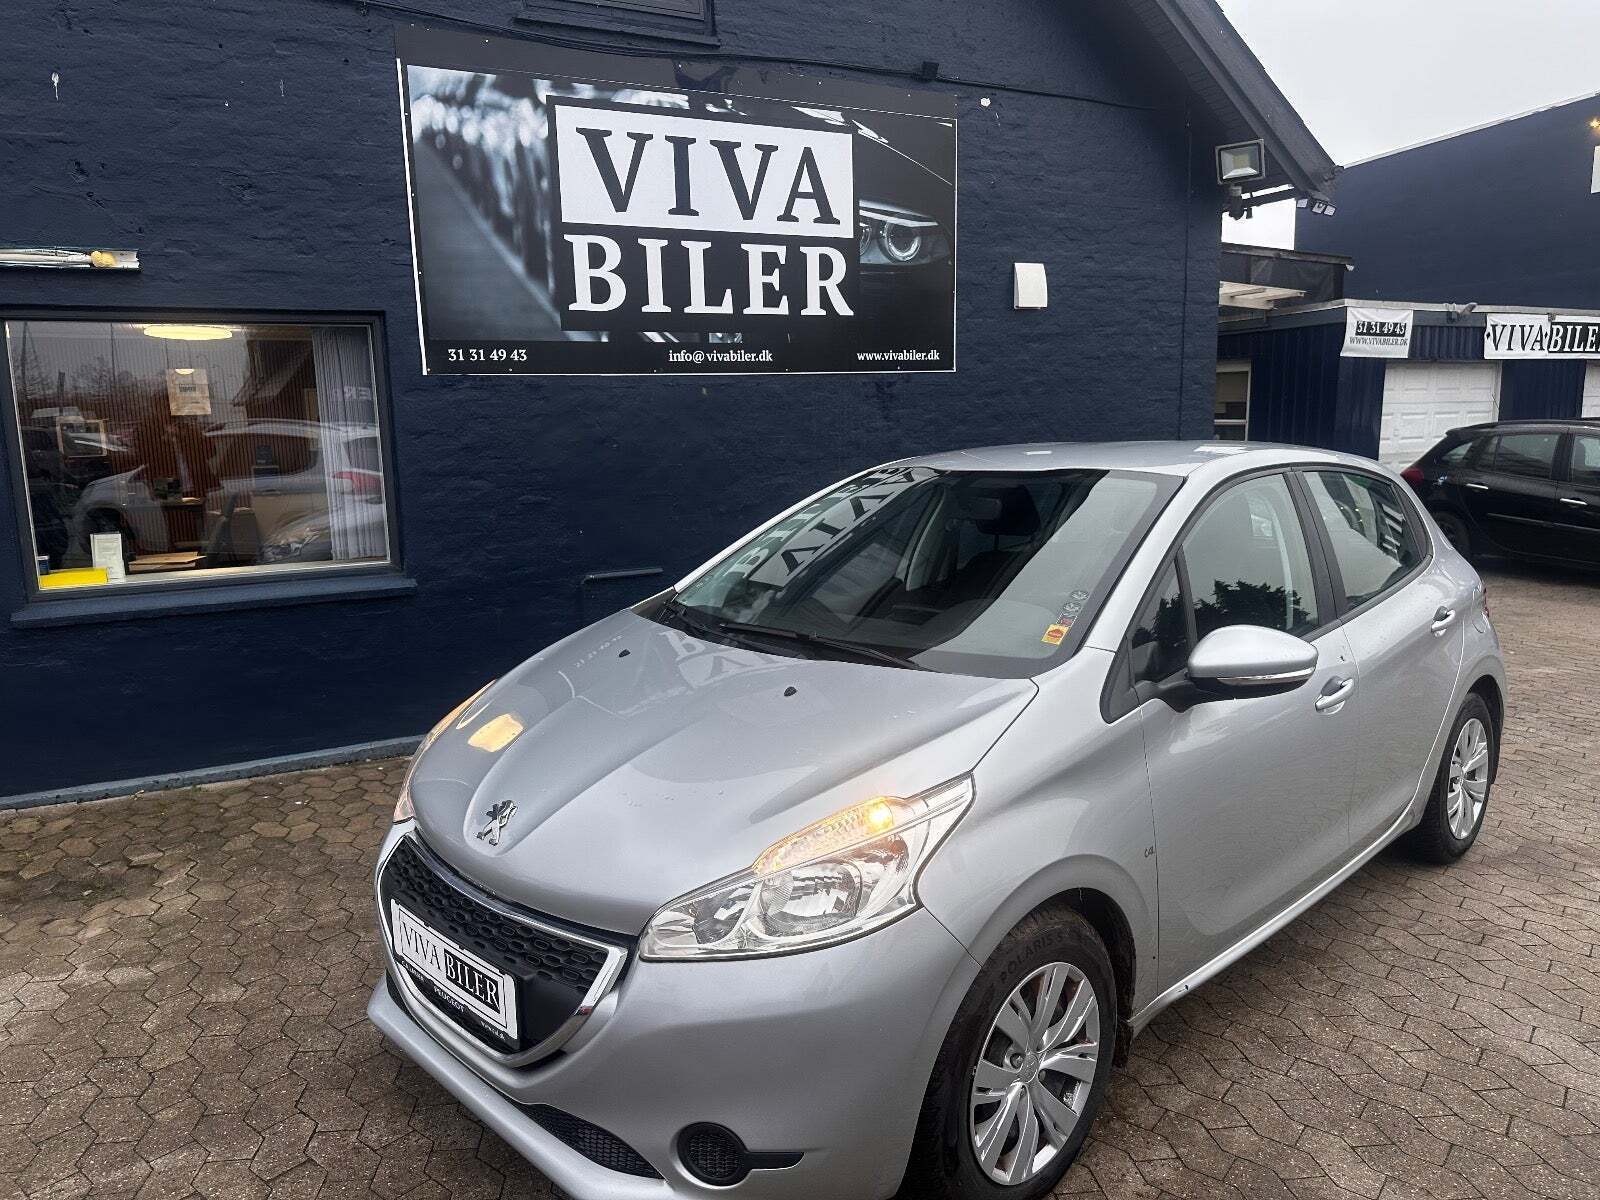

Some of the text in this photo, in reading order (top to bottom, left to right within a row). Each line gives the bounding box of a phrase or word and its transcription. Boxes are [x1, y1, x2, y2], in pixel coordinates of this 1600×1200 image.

[576, 127, 841, 225] VIVA
[563, 234, 854, 316] BILER
[1357, 321, 1405, 334] 31 31 49 43
[1490, 324, 1600, 352] VIVA BILE
[448, 349, 528, 361] 31 31 49 43
[668, 349, 773, 363] info@vivabiler.dk
[856, 349, 940, 361] www.vivabiler.dk
[400, 921, 442, 971] VIVA
[444, 952, 501, 1011] BILER
